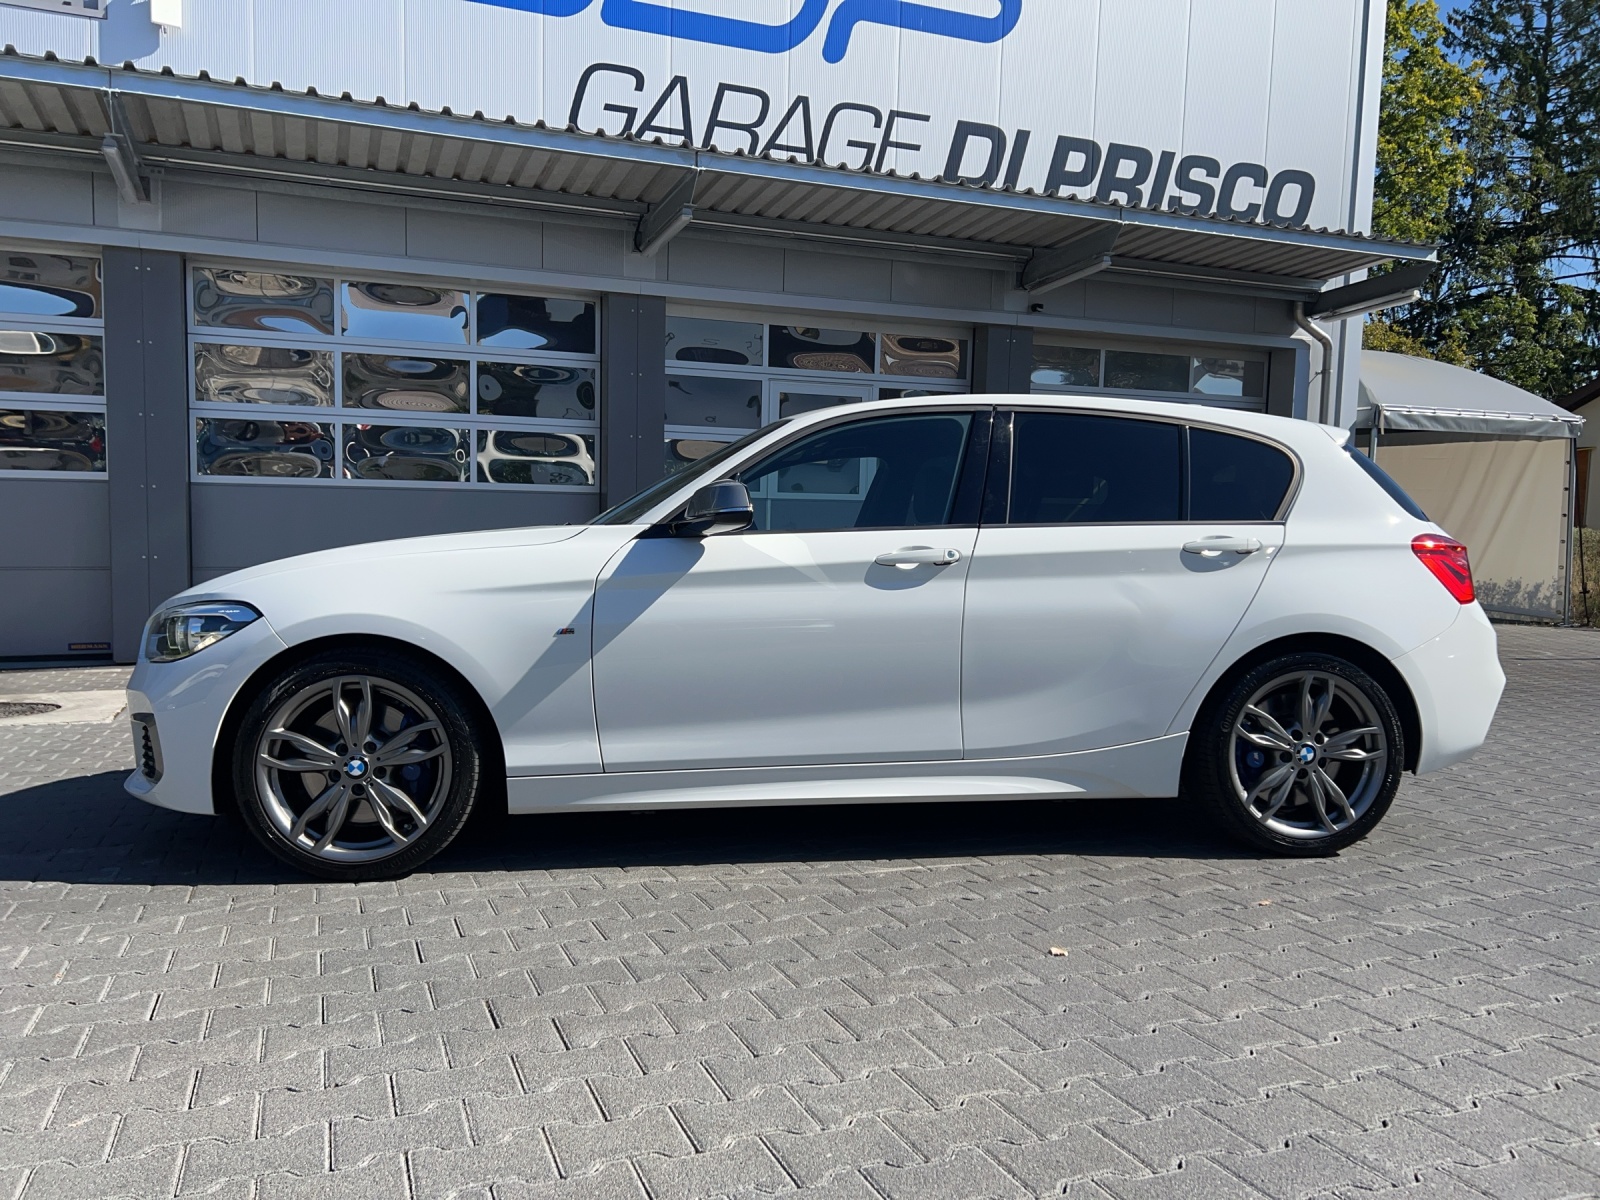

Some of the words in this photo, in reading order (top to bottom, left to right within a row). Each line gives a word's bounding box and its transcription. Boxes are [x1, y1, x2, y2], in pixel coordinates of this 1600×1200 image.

[569, 62, 931, 172] GARAGE
[943, 119, 1031, 189] DI
[1044, 134, 1316, 227] PRISCO
